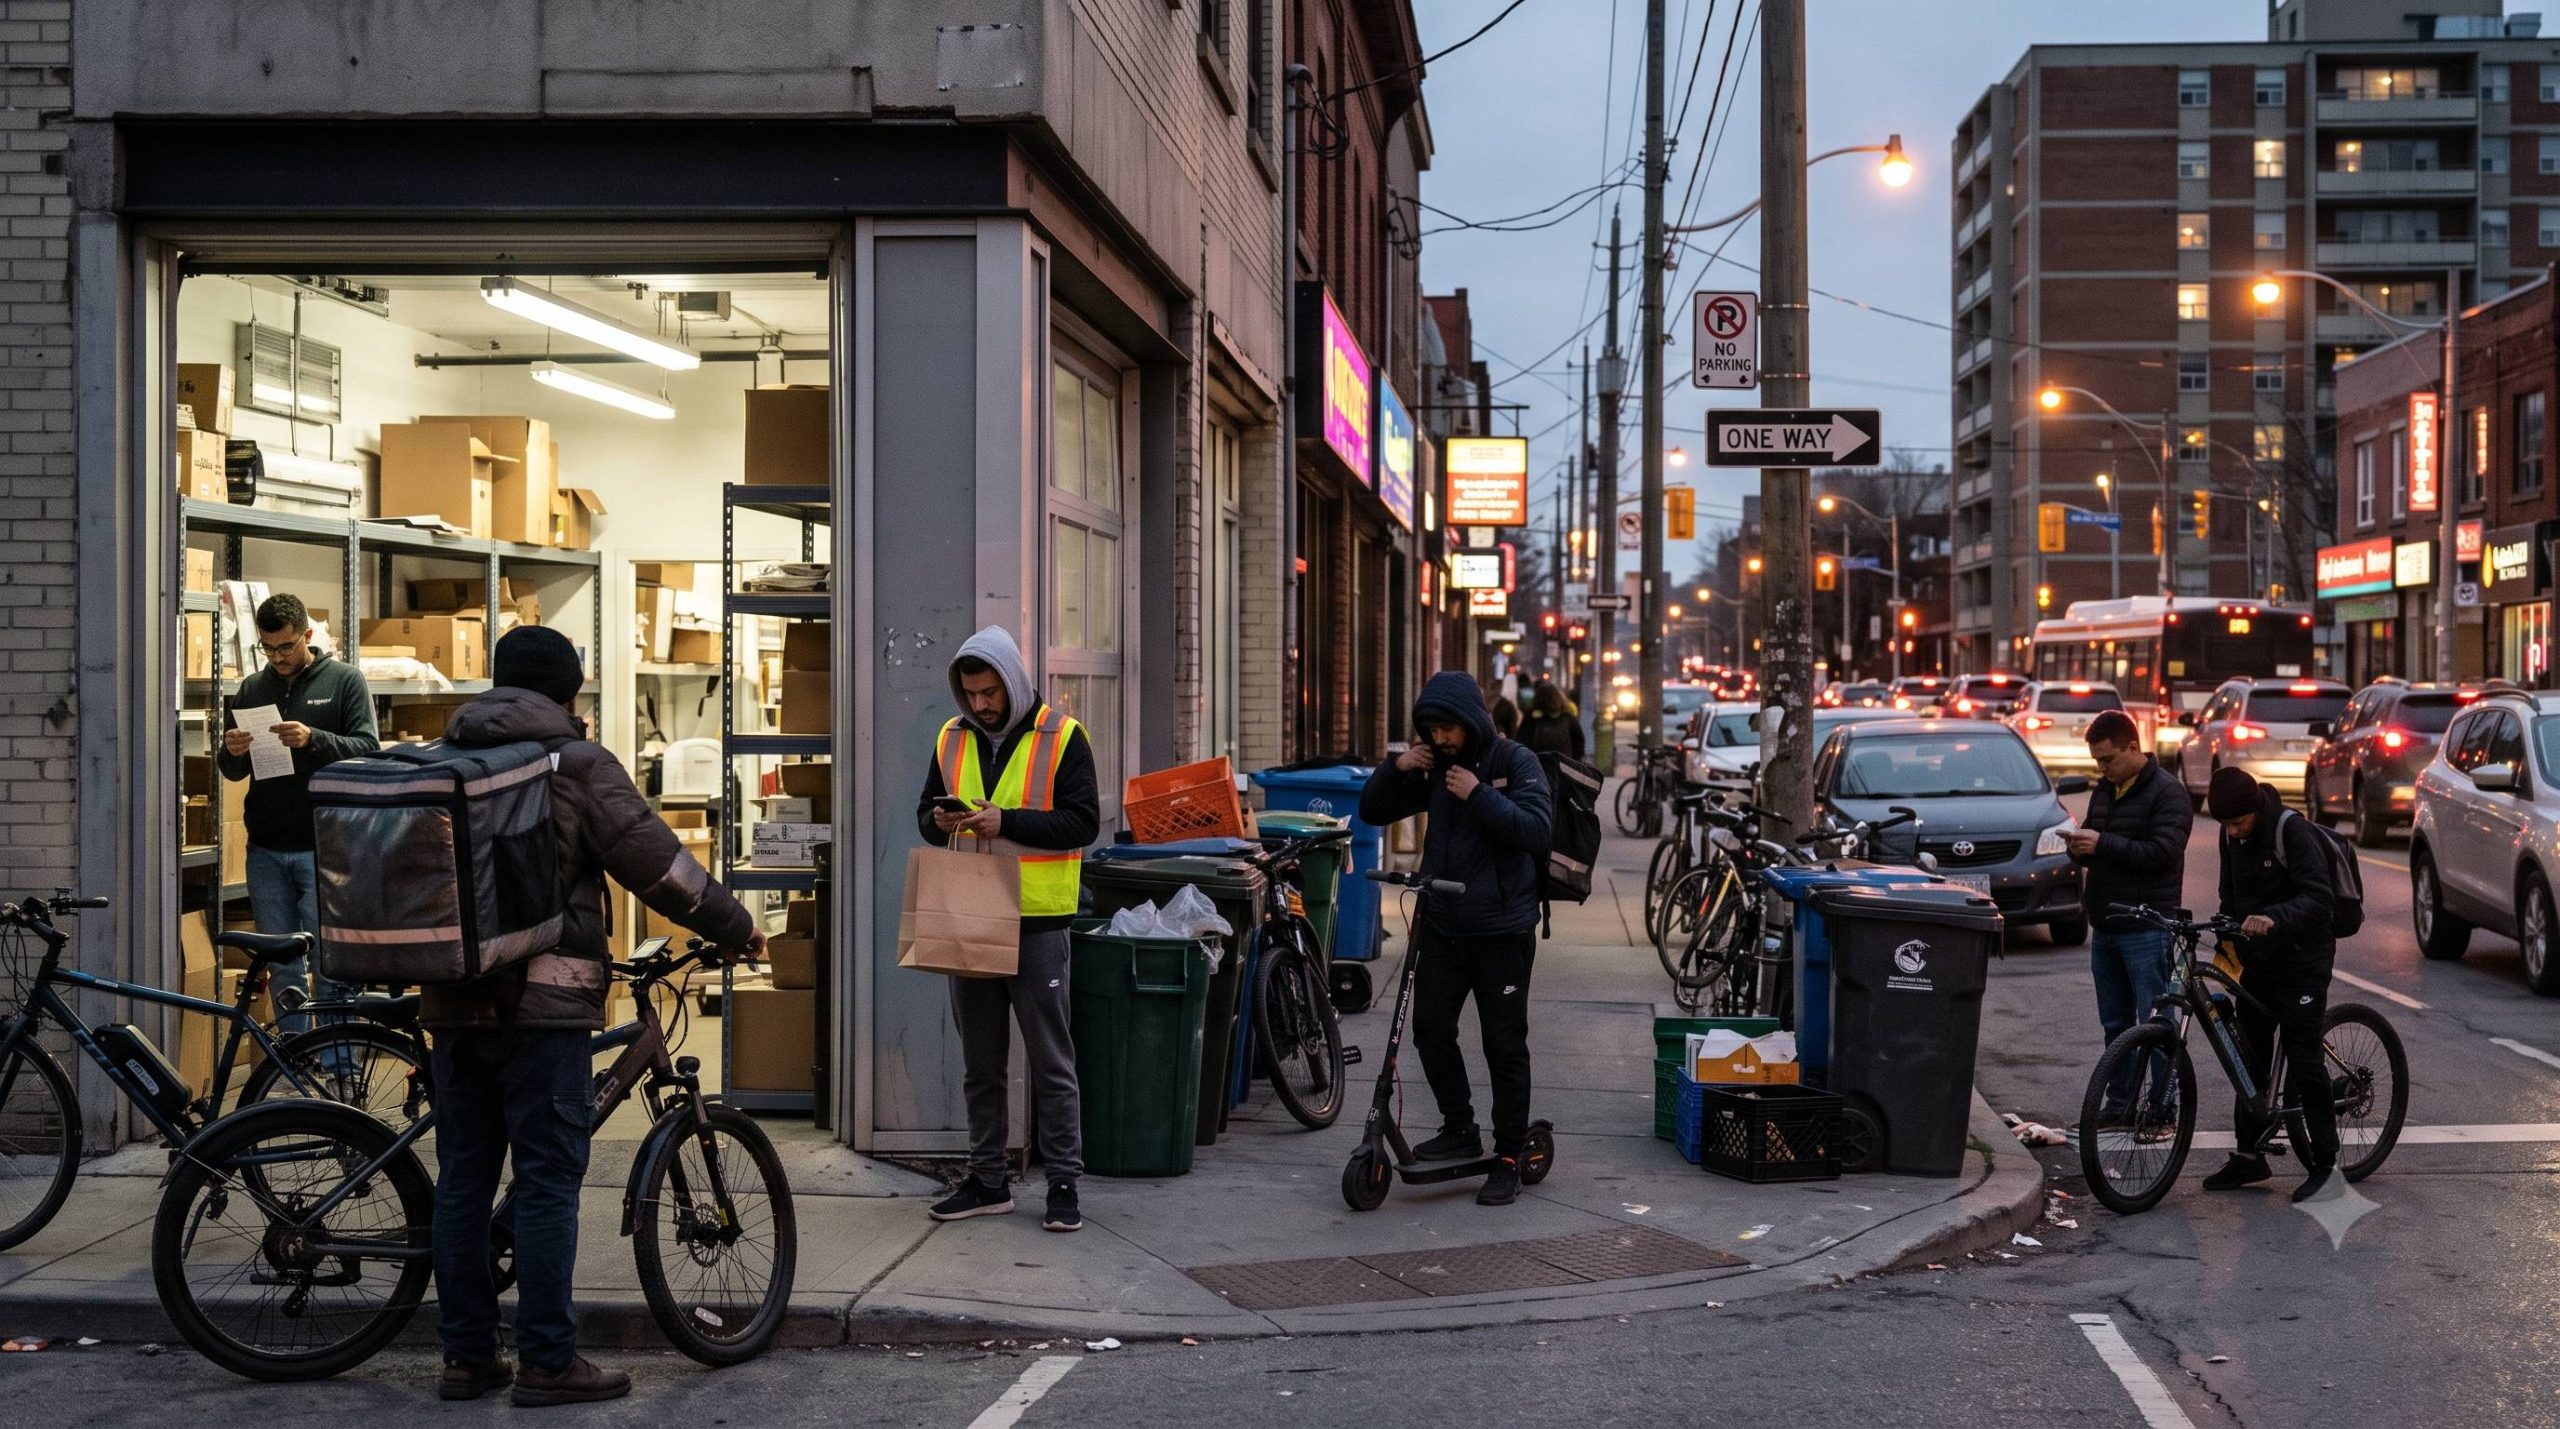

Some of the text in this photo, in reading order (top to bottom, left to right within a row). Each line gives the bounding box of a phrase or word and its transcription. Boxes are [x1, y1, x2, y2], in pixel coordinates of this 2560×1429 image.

[1714, 342, 1737, 357] NO
[1699, 358, 1752, 372] PARKING
[1726, 427, 1833, 449] ONE WAY
